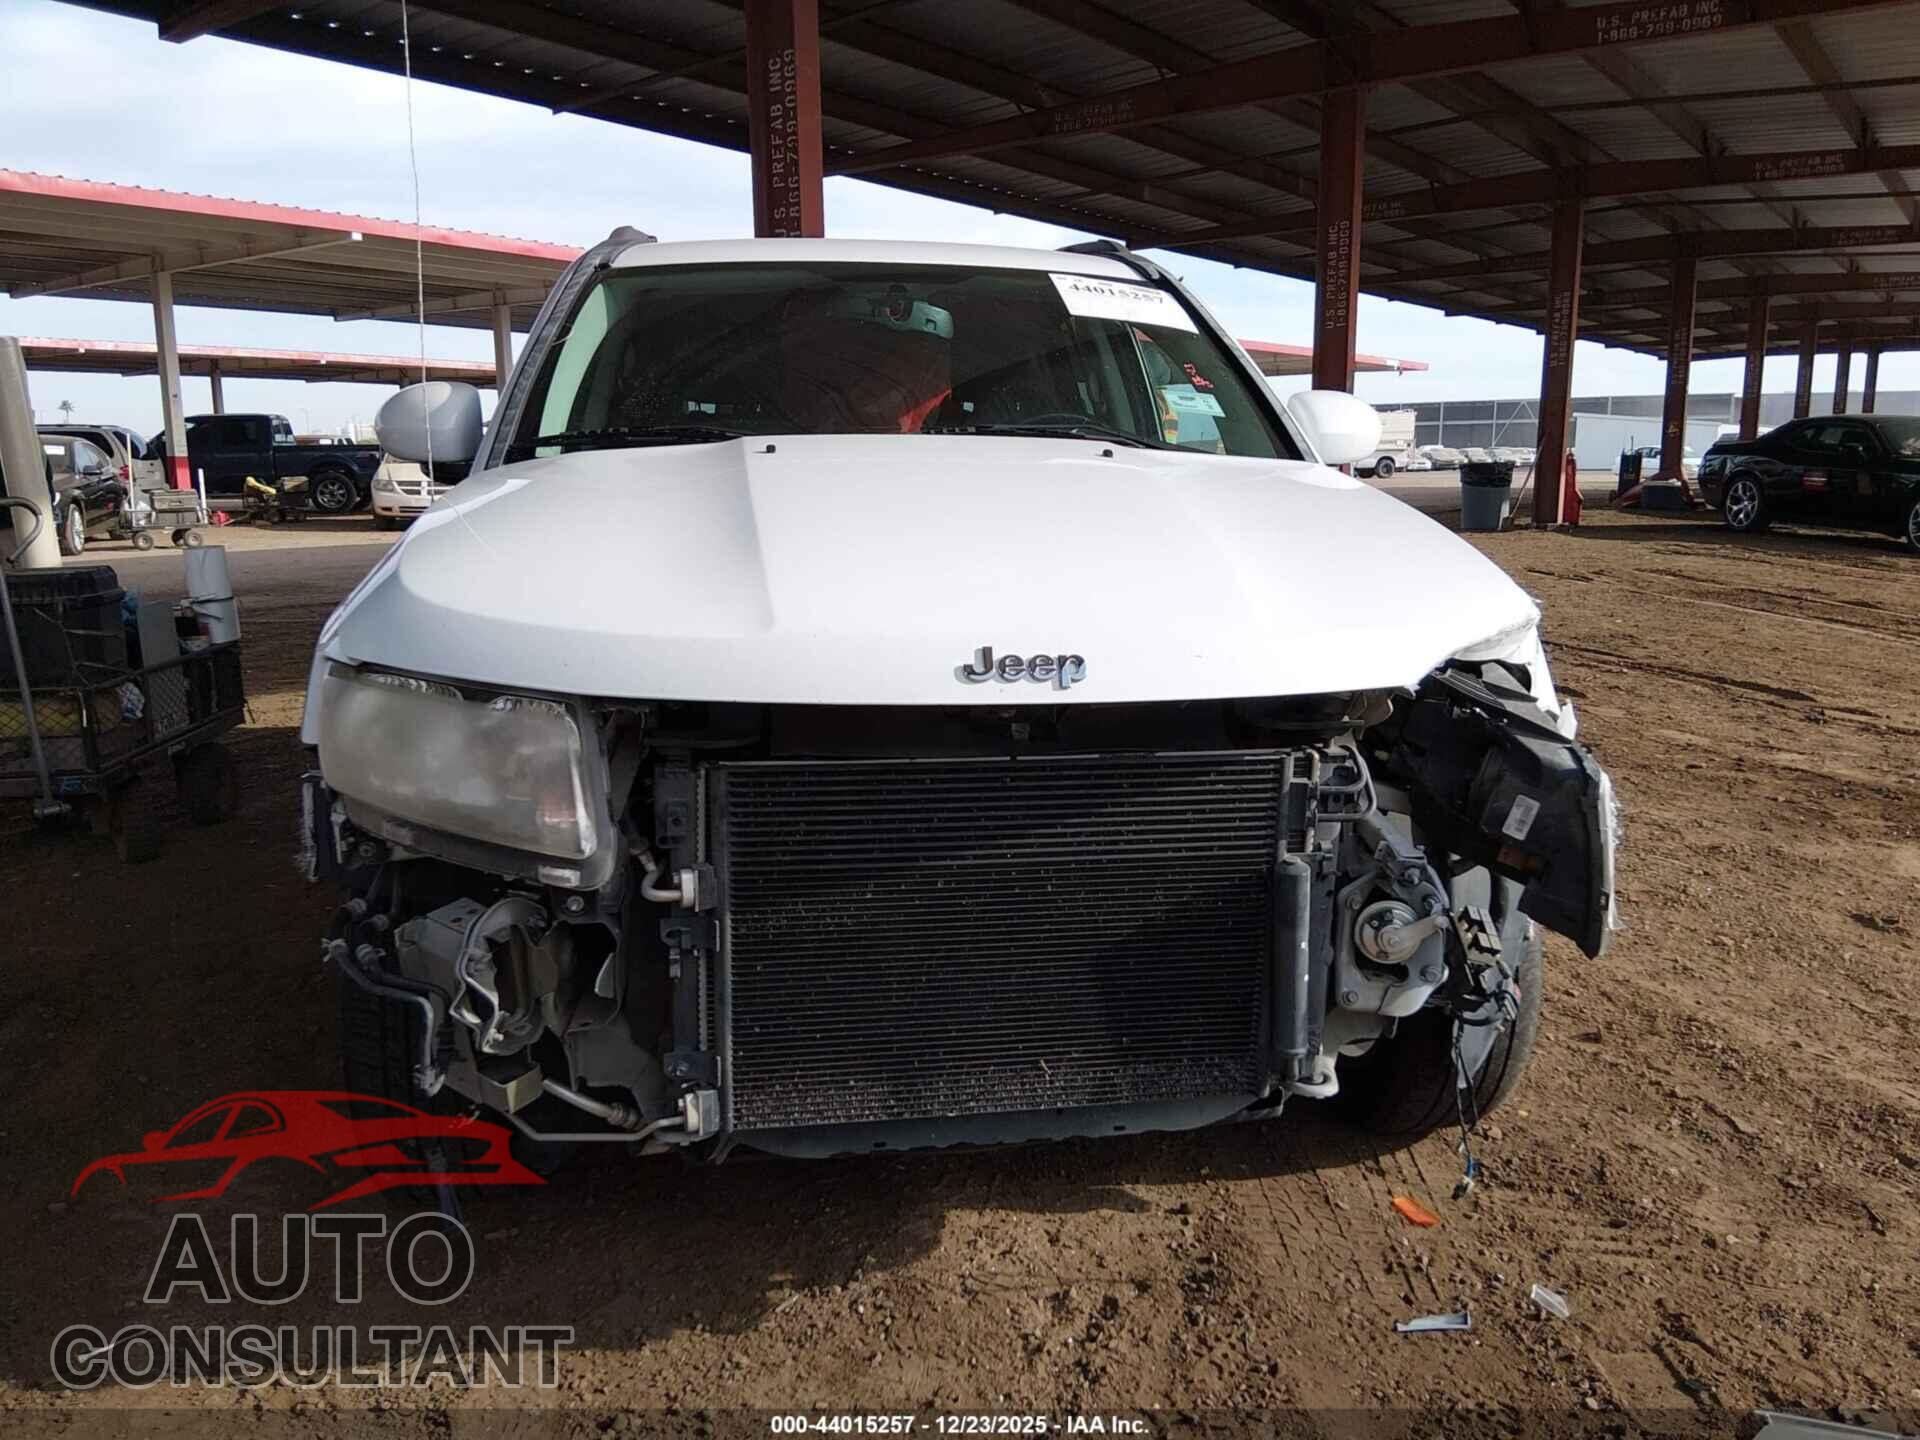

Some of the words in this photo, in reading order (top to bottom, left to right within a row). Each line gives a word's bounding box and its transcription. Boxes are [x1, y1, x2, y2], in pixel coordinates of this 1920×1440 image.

[1631, 3, 1689, 24] PREFAB
[767, 49, 782, 92] INC.
[769, 103, 785, 188] PREFAB
[1325, 250, 1338, 299] PREFAB
[956, 646, 1087, 690] Jeep
